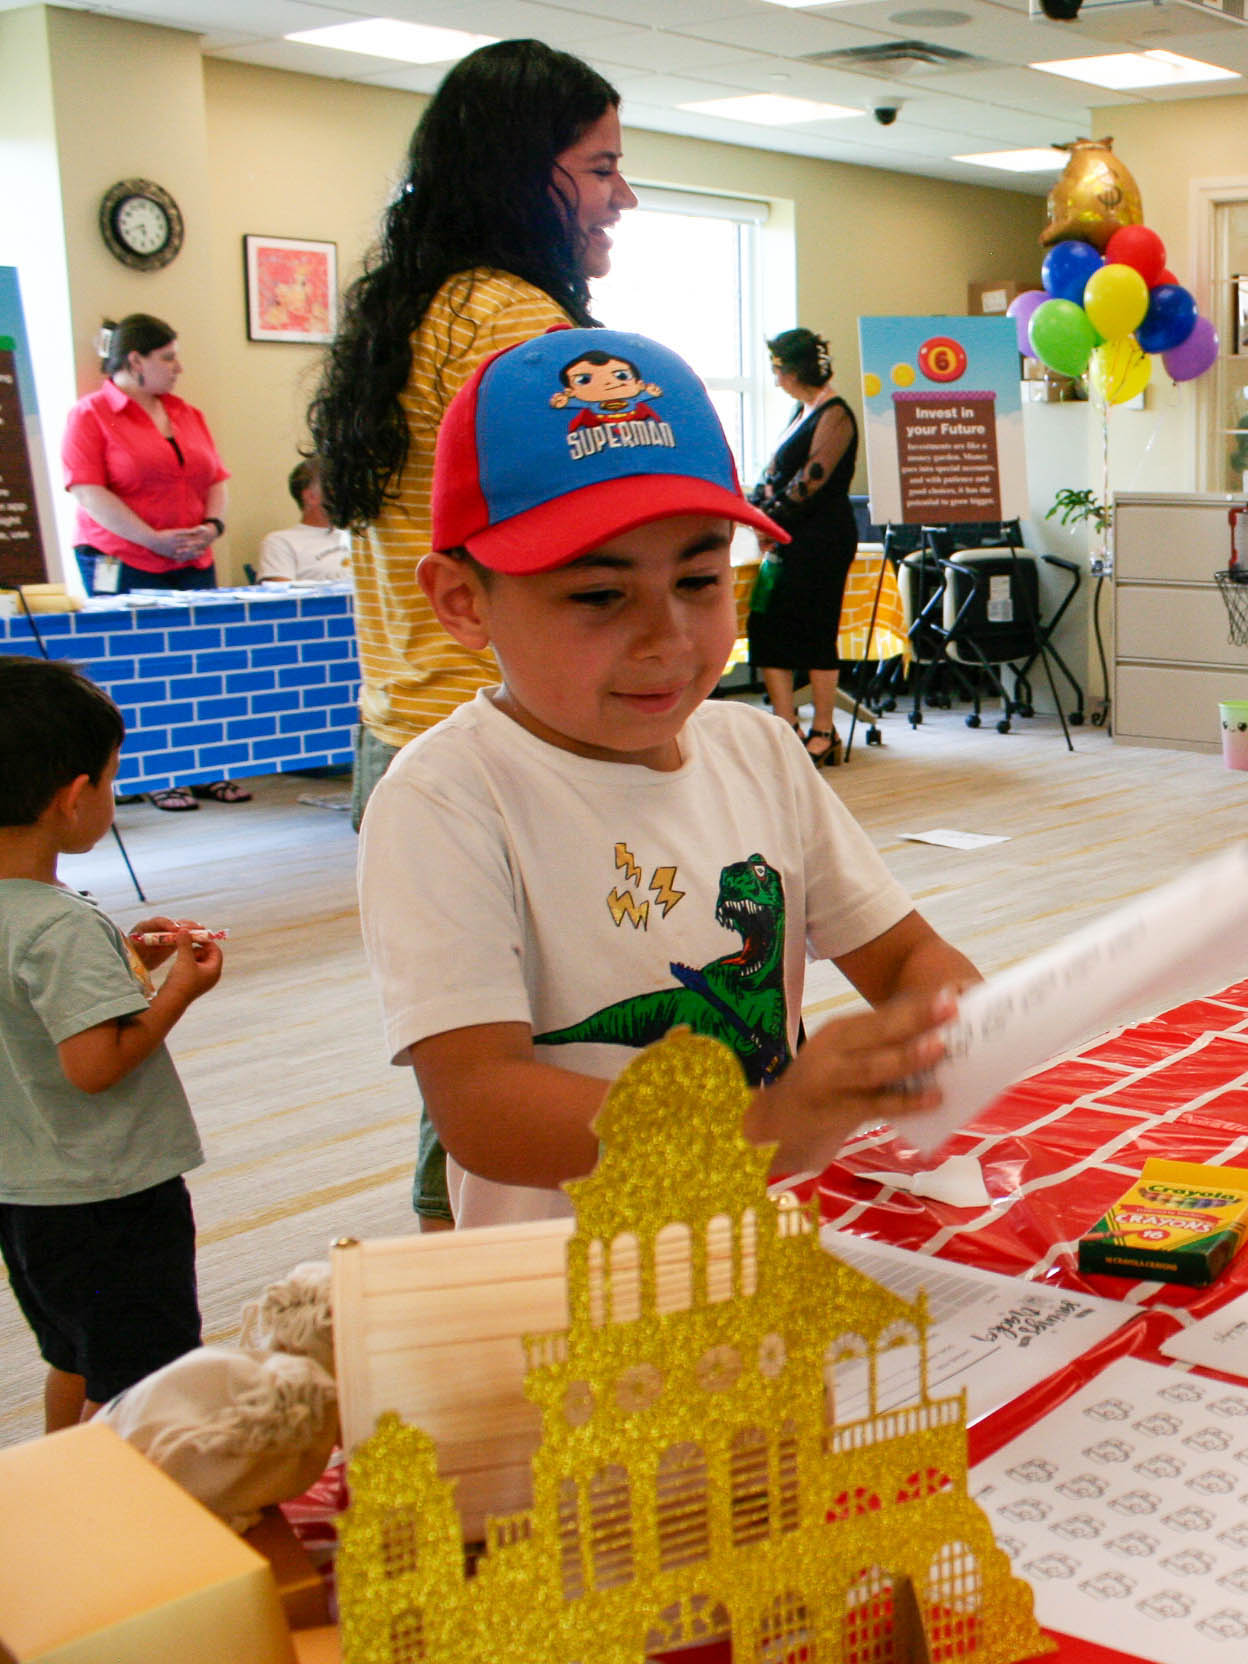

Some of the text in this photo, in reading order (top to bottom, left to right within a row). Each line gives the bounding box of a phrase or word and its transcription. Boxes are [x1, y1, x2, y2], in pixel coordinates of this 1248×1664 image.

[934, 350, 949, 371] 6
[915, 407, 974, 419] Invest in
[906, 424, 986, 438] your Future
[567, 420, 676, 461] SUPERMAN
[1147, 1184, 1237, 1201] Crayola
[1113, 1211, 1214, 1235] CRAYONS
[1142, 1229, 1165, 1241] 16
